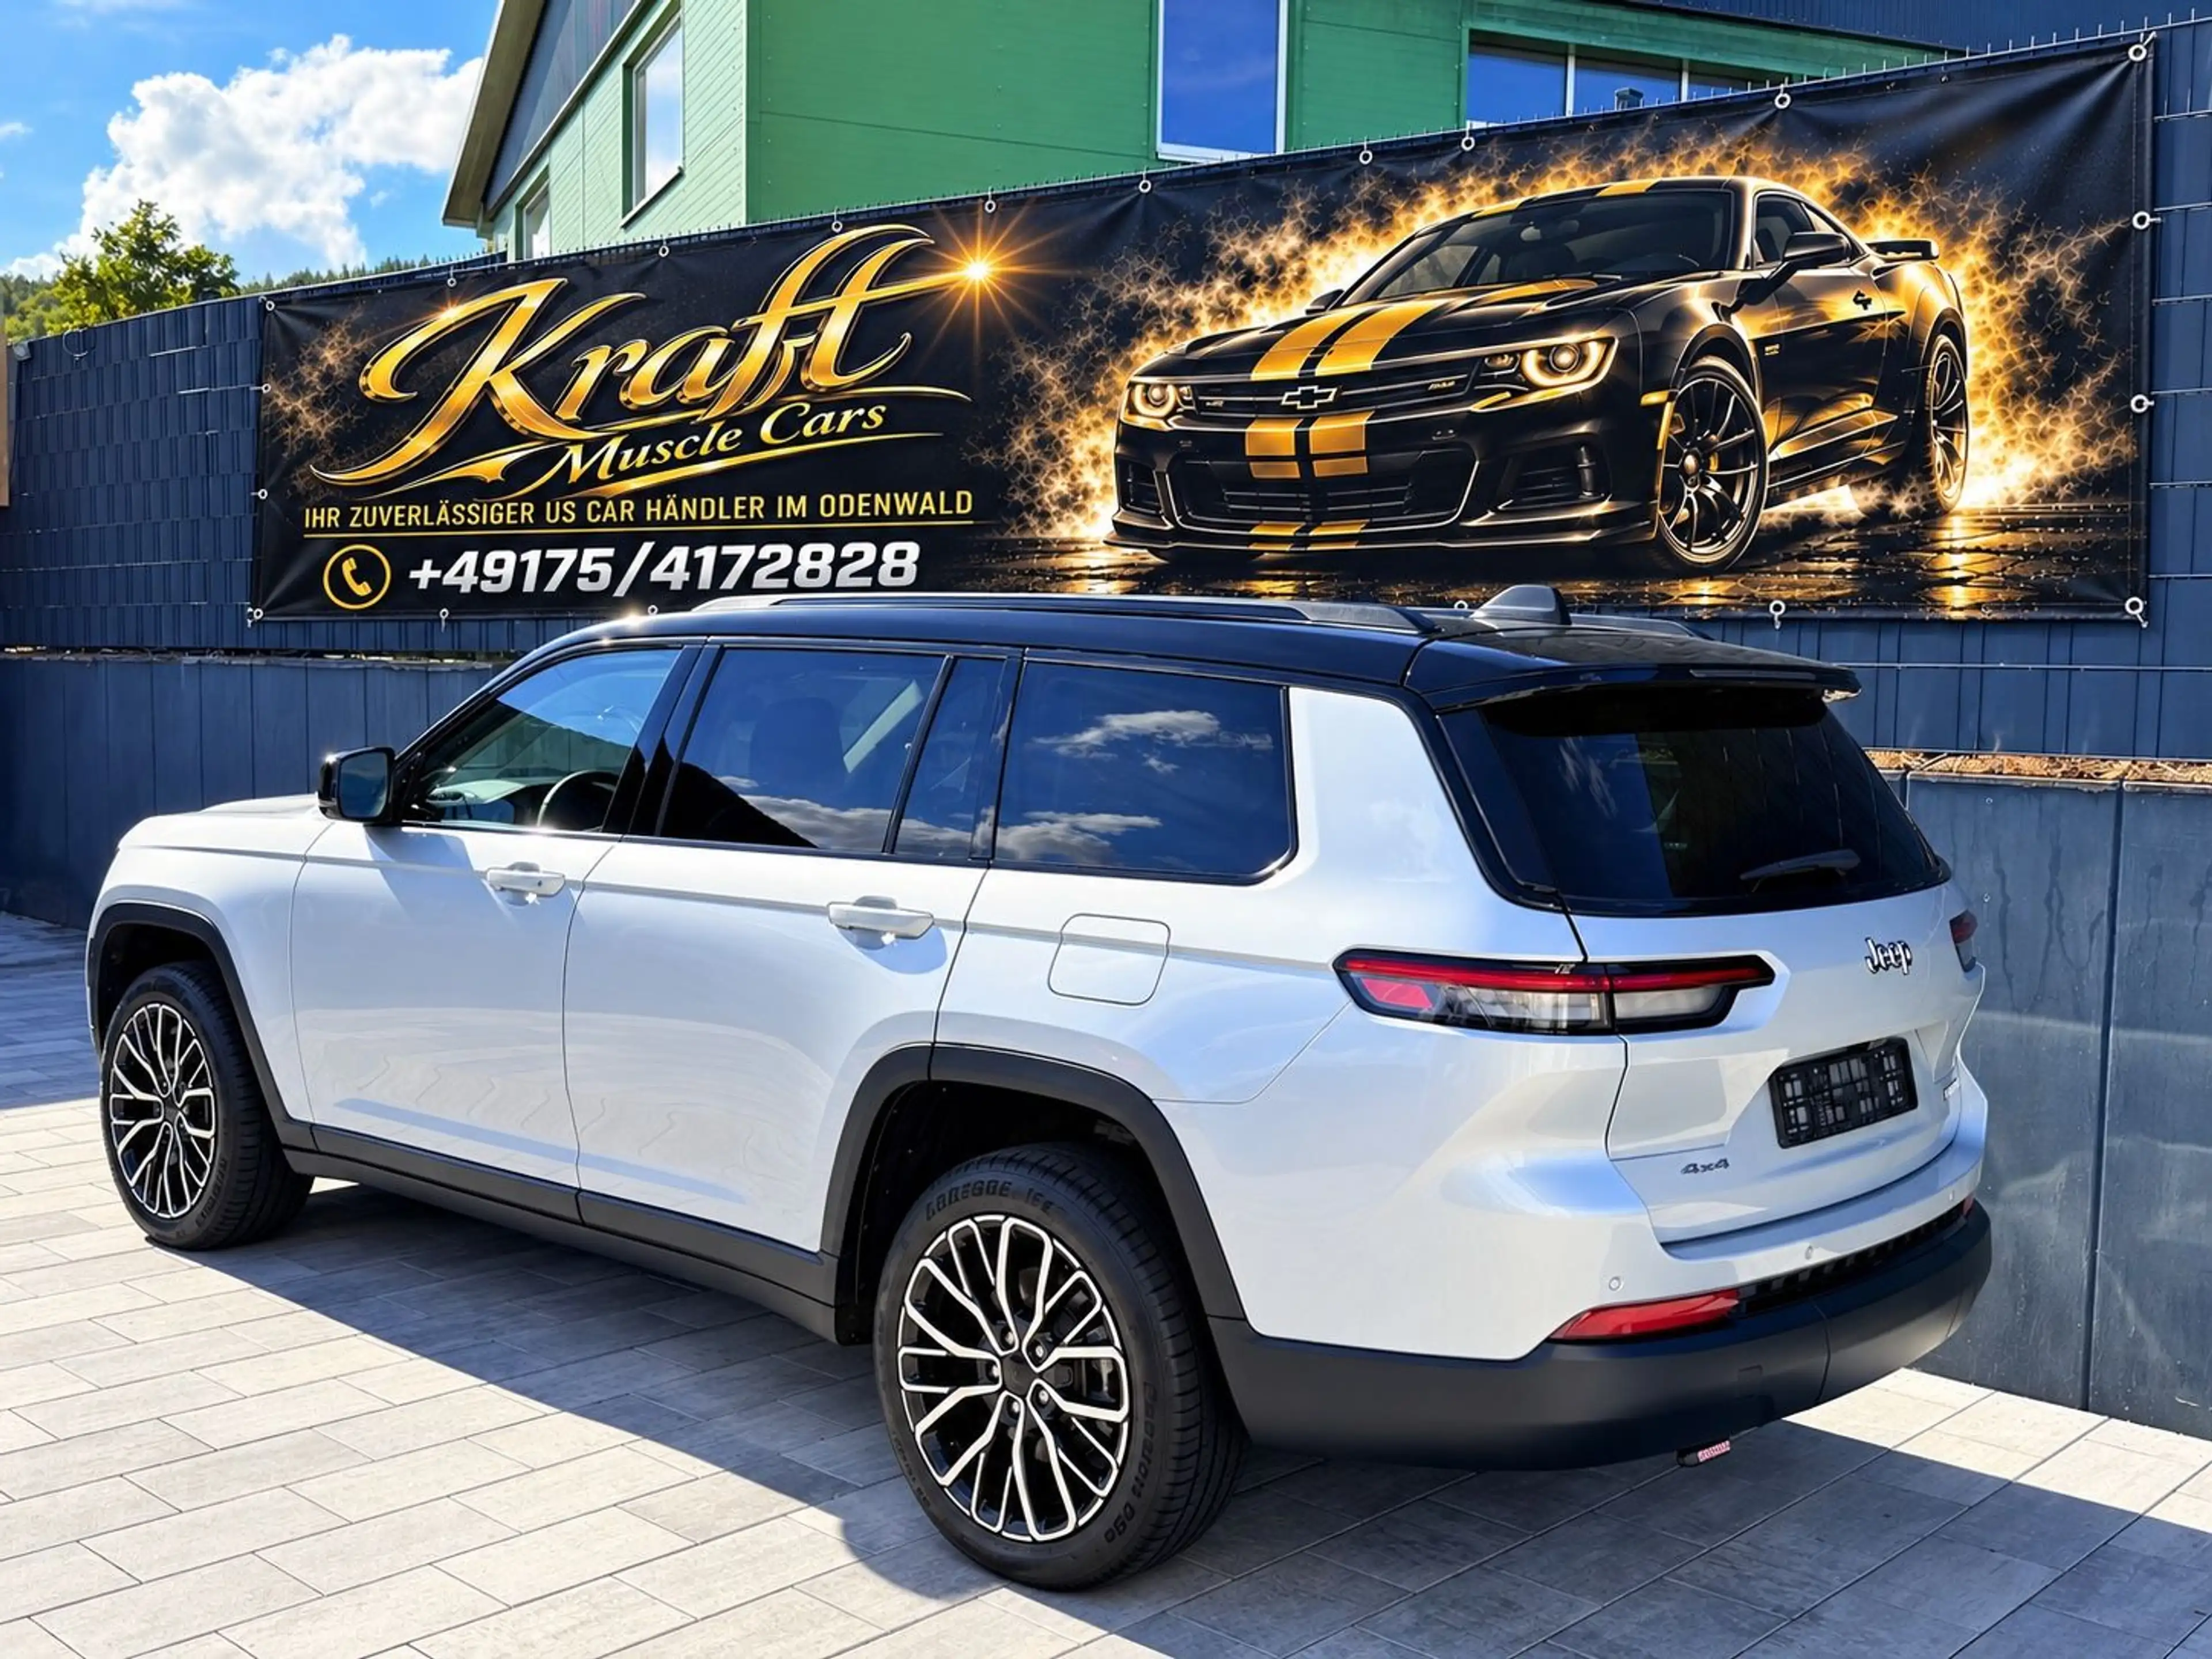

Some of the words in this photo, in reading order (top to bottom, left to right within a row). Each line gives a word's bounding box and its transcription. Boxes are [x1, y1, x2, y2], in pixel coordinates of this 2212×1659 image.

[311, 224, 939, 485] Kraft
[514, 419, 743, 495] Muscle
[759, 401, 887, 445] Cars
[305, 506, 341, 529] IHR
[349, 499, 535, 528] ZUVERLÄSSIGER
[546, 500, 577, 524] US
[586, 499, 635, 523] CAR
[645, 494, 766, 521] HÄNDLER
[777, 495, 807, 518] IM
[819, 490, 974, 518] ODENWALD
[408, 540, 922, 598] +49175/4172828
[1864, 936, 1913, 975] Jeep
[1681, 1158, 1730, 1175] 4x4
